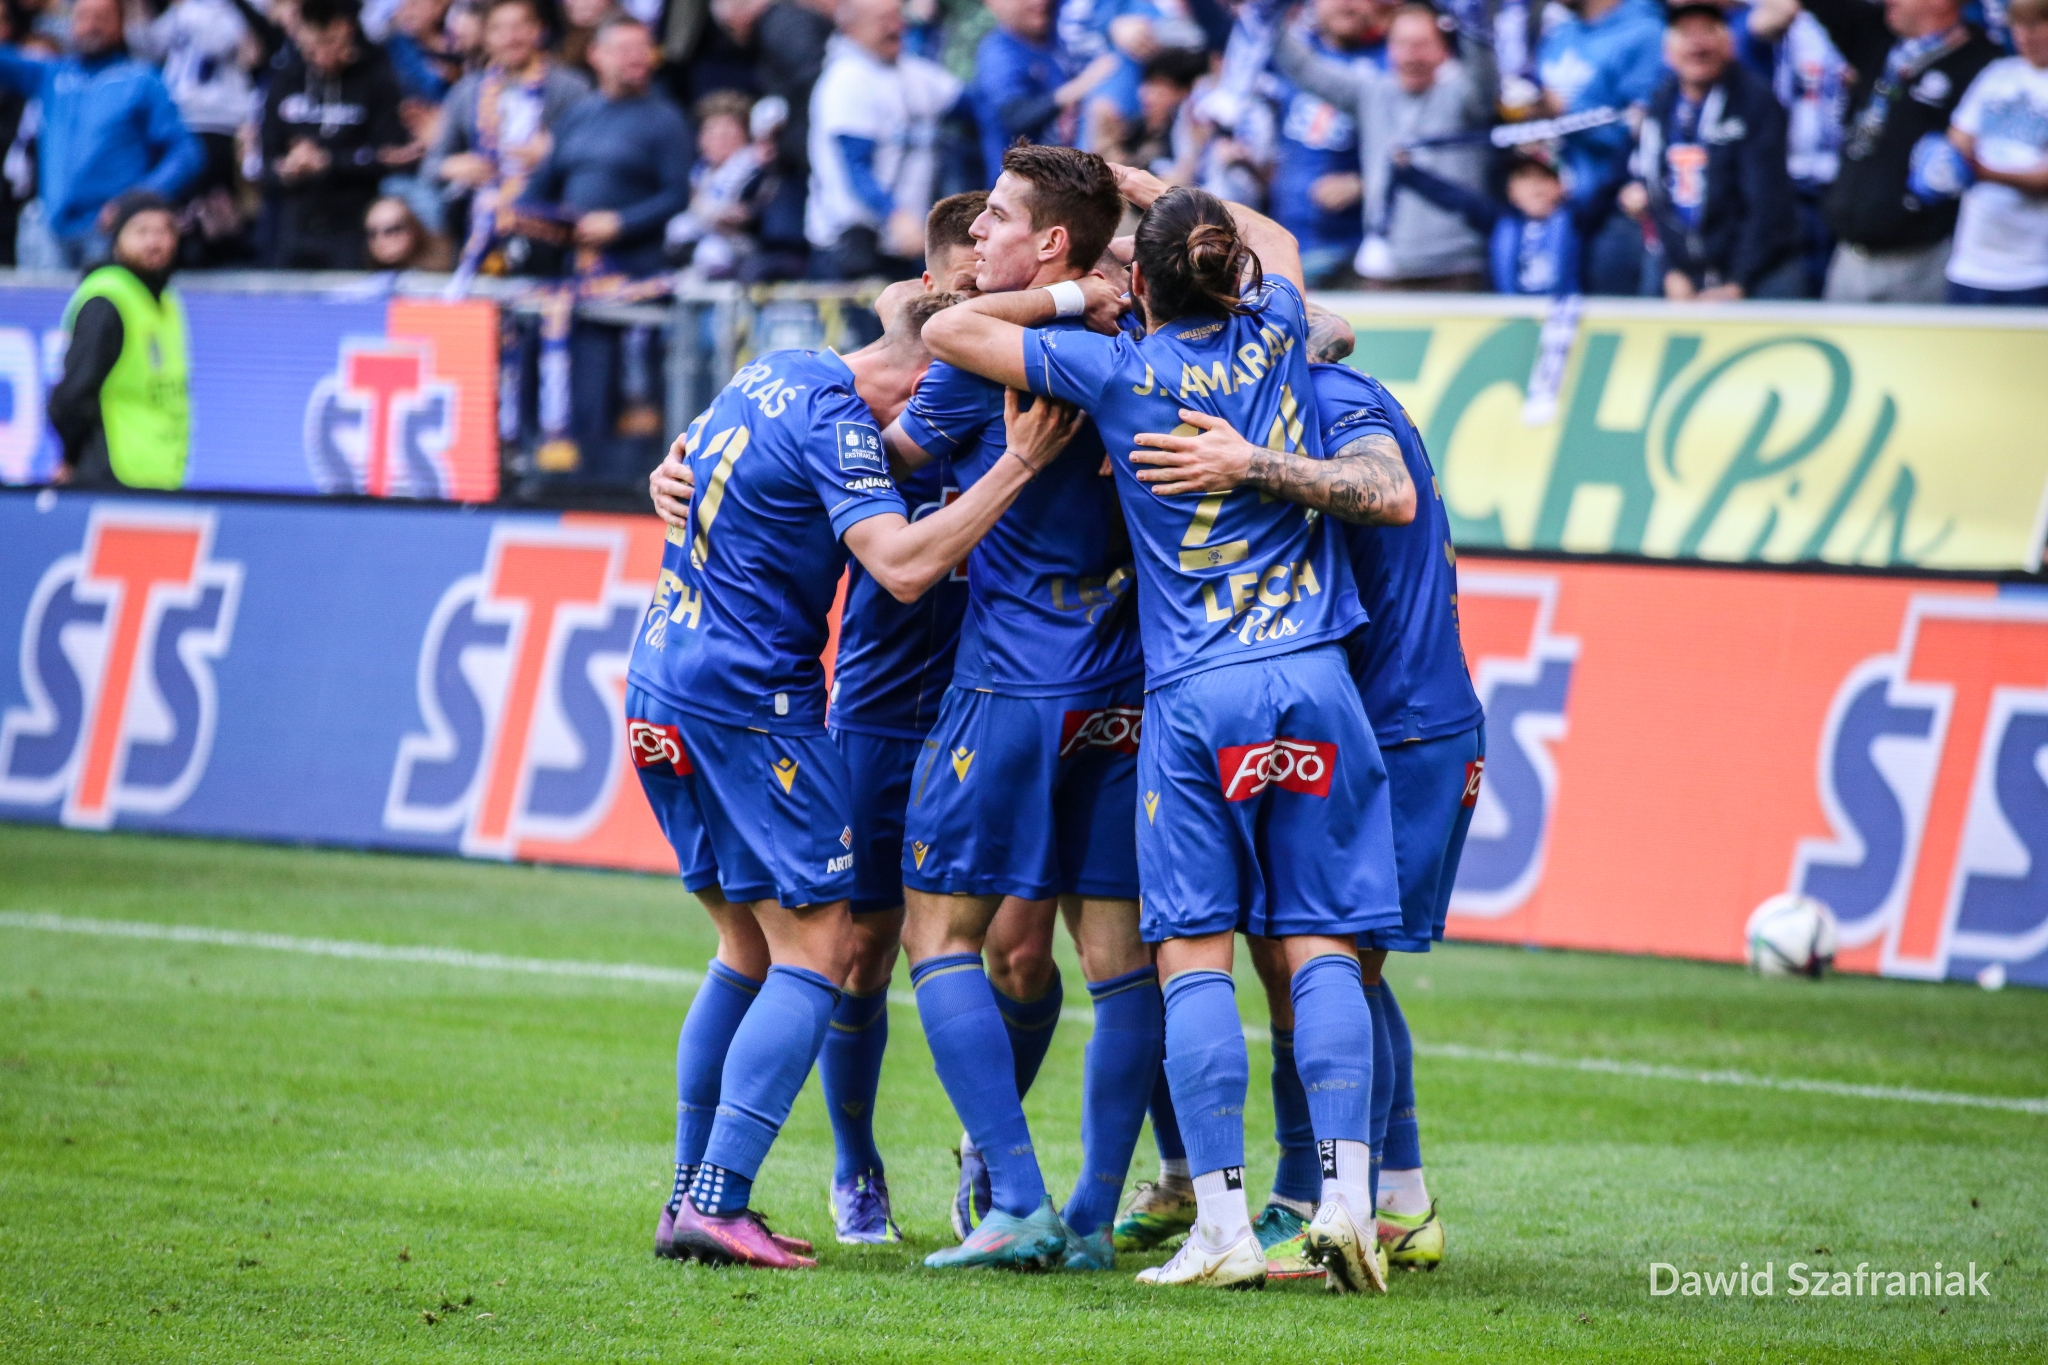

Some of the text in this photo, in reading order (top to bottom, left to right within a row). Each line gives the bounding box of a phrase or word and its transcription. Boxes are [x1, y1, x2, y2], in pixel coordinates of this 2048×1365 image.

[1132, 322, 1295, 399] J. AMARAL
[845, 477, 892, 490] CANAL+
[1201, 559, 1321, 623] LECH
[1228, 606, 1304, 646] Pils
[0, 502, 244, 830] STS
[383, 523, 664, 862] STS
